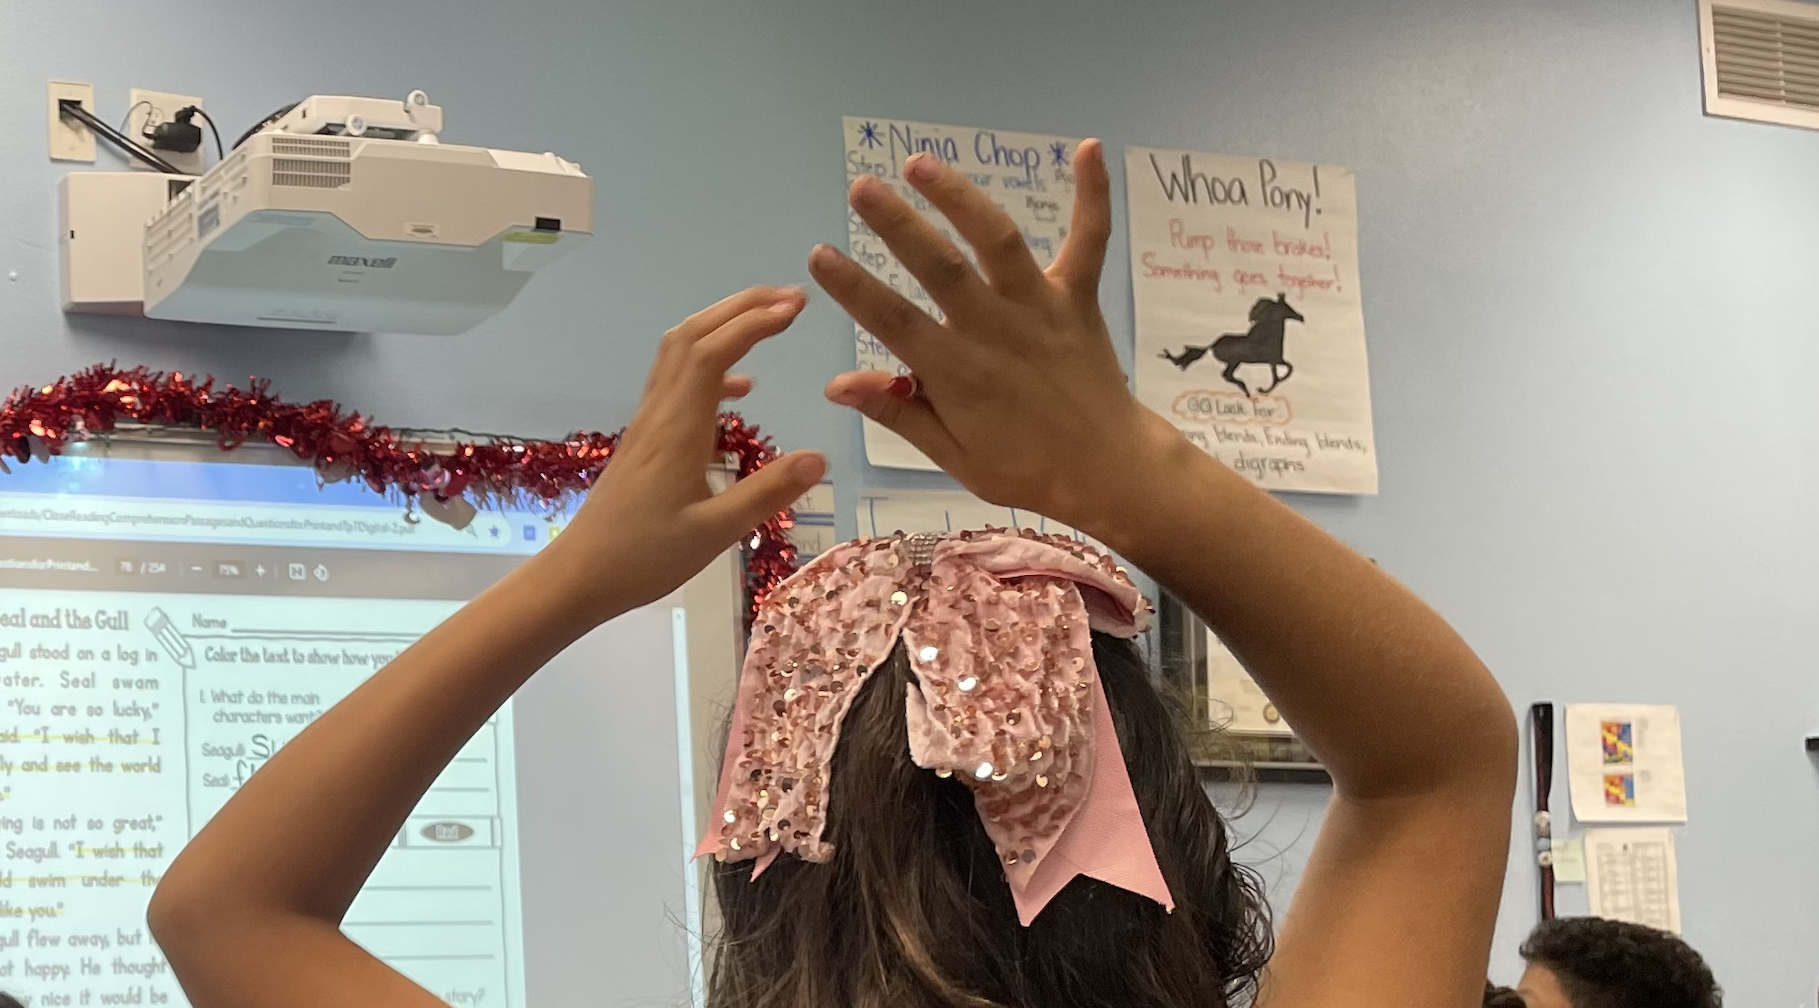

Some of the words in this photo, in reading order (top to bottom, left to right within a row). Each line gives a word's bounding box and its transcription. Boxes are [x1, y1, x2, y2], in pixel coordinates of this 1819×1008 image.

[847, 150, 887, 178] Step
[974, 131, 1040, 182] Chop
[1149, 152, 1248, 206] Whoa
[1258, 158, 1322, 229] Pony!
[1169, 218, 1215, 260] Pump
[852, 240, 887, 272] Step
[1141, 251, 1222, 293] Something
[1233, 450, 1305, 479] digraphs
[29, 609, 62, 630] and
[64, 609, 93, 630] the
[95, 611, 129, 631] Gull
[192, 613, 227, 630] Name
[29, 643, 70, 661] stood
[101, 650, 111, 662] a
[117, 644, 139, 666] log
[146, 647, 158, 662] in
[204, 646, 237, 663] Color
[240, 647, 260, 663] the
[263, 647, 290, 664] text
[293, 649, 305, 664] to
[307, 648, 340, 666] show
[342, 649, 369, 666] how
[60, 671, 96, 690] Seal
[112, 674, 159, 690] swam
[210, 689, 244, 704] What
[247, 689, 264, 705] do
[267, 690, 288, 705] the
[50, 705, 77, 717] are
[86, 706, 103, 718] so
[212, 709, 282, 724] characters
[63, 729, 95, 745] wish
[109, 729, 140, 746] that
[151, 727, 161, 746] I
[21, 755, 49, 773] and
[56, 758, 81, 773] see
[88, 755, 114, 773] the
[121, 755, 161, 774] world
[33, 815, 44, 830] is
[53, 814, 77, 830] not
[87, 818, 103, 831] so
[92, 842, 125, 860] wish
[131, 841, 163, 860] that
[28, 873, 66, 888] swim
[81, 869, 124, 888] under
[27, 928, 61, 948] flew
[67, 931, 111, 952] away,
[117, 928, 141, 946] but
[25, 957, 71, 981] happy.
[81, 958, 101, 976] He
[111, 956, 167, 977] thought
[41, 990, 71, 1007] nice
[80, 989, 91, 1006] it
[100, 985, 142, 1006] would
[150, 985, 168, 1004] be
